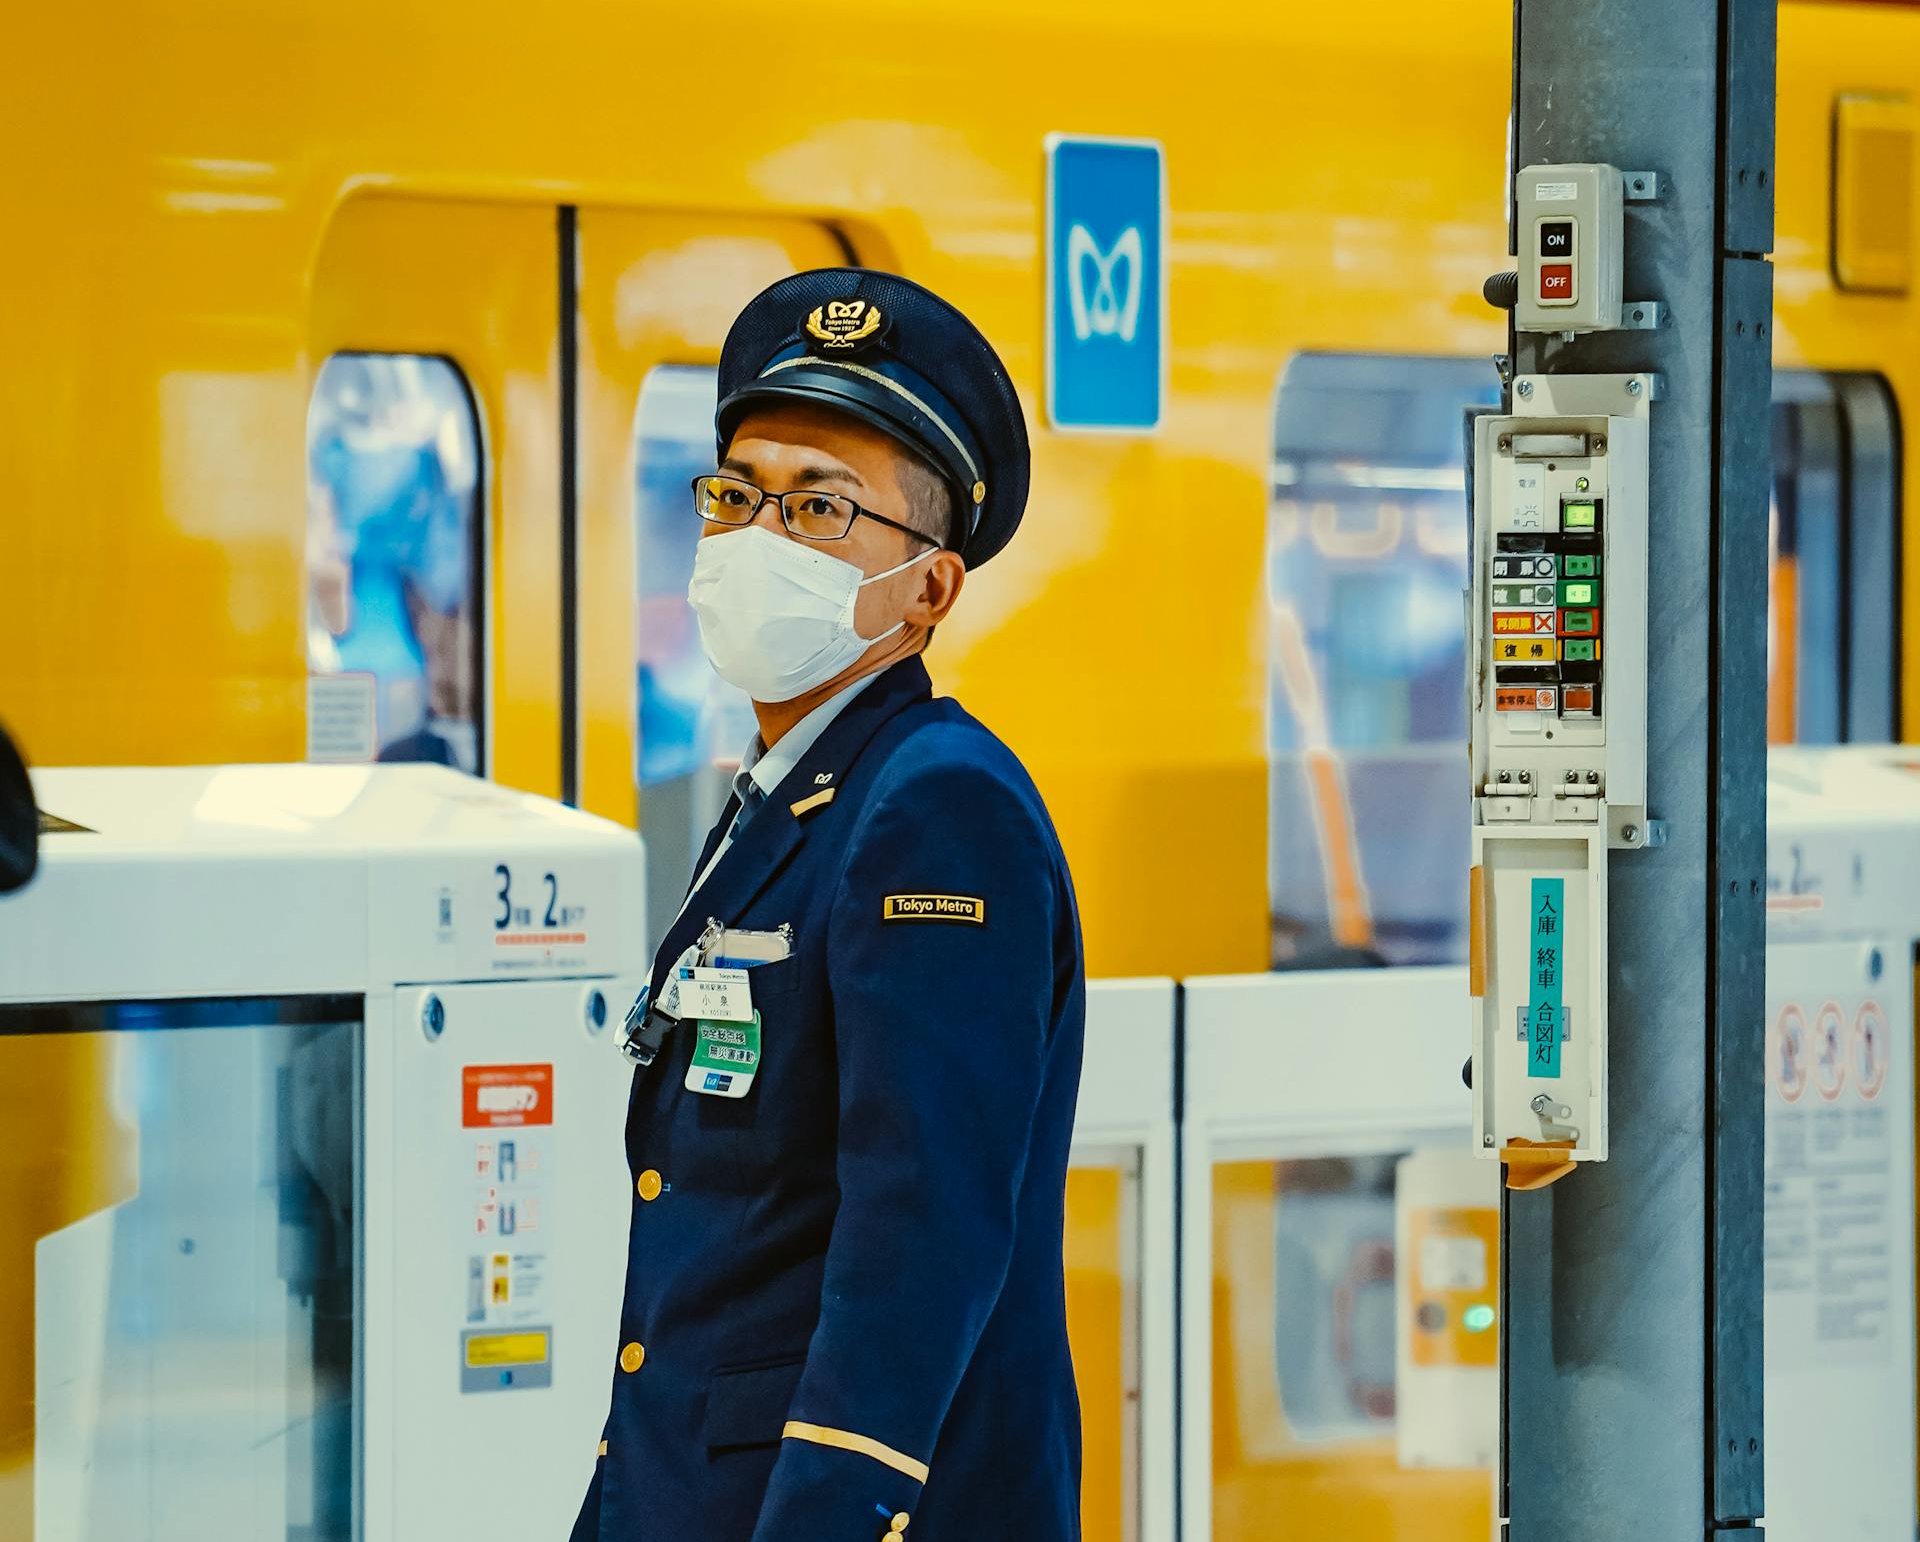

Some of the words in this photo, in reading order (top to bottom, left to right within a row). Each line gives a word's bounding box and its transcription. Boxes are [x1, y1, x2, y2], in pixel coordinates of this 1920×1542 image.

[1547, 234, 1565, 246] ON
[1545, 276, 1567, 288] OFF
[825, 318, 842, 326] Tokyo
[842, 318, 860, 326] Metro
[1504, 644, 1544, 657] 復帰
[1497, 695, 1535, 706] 非常停止
[495, 864, 511, 930] 3
[544, 872, 558, 928] 2
[896, 899, 934, 914] Tokyo
[935, 899, 974, 914] Metro
[1537, 895, 1557, 936] 入庫
[1536, 948, 1556, 990] 終車
[1535, 1001, 1555, 1065] 合図灯
